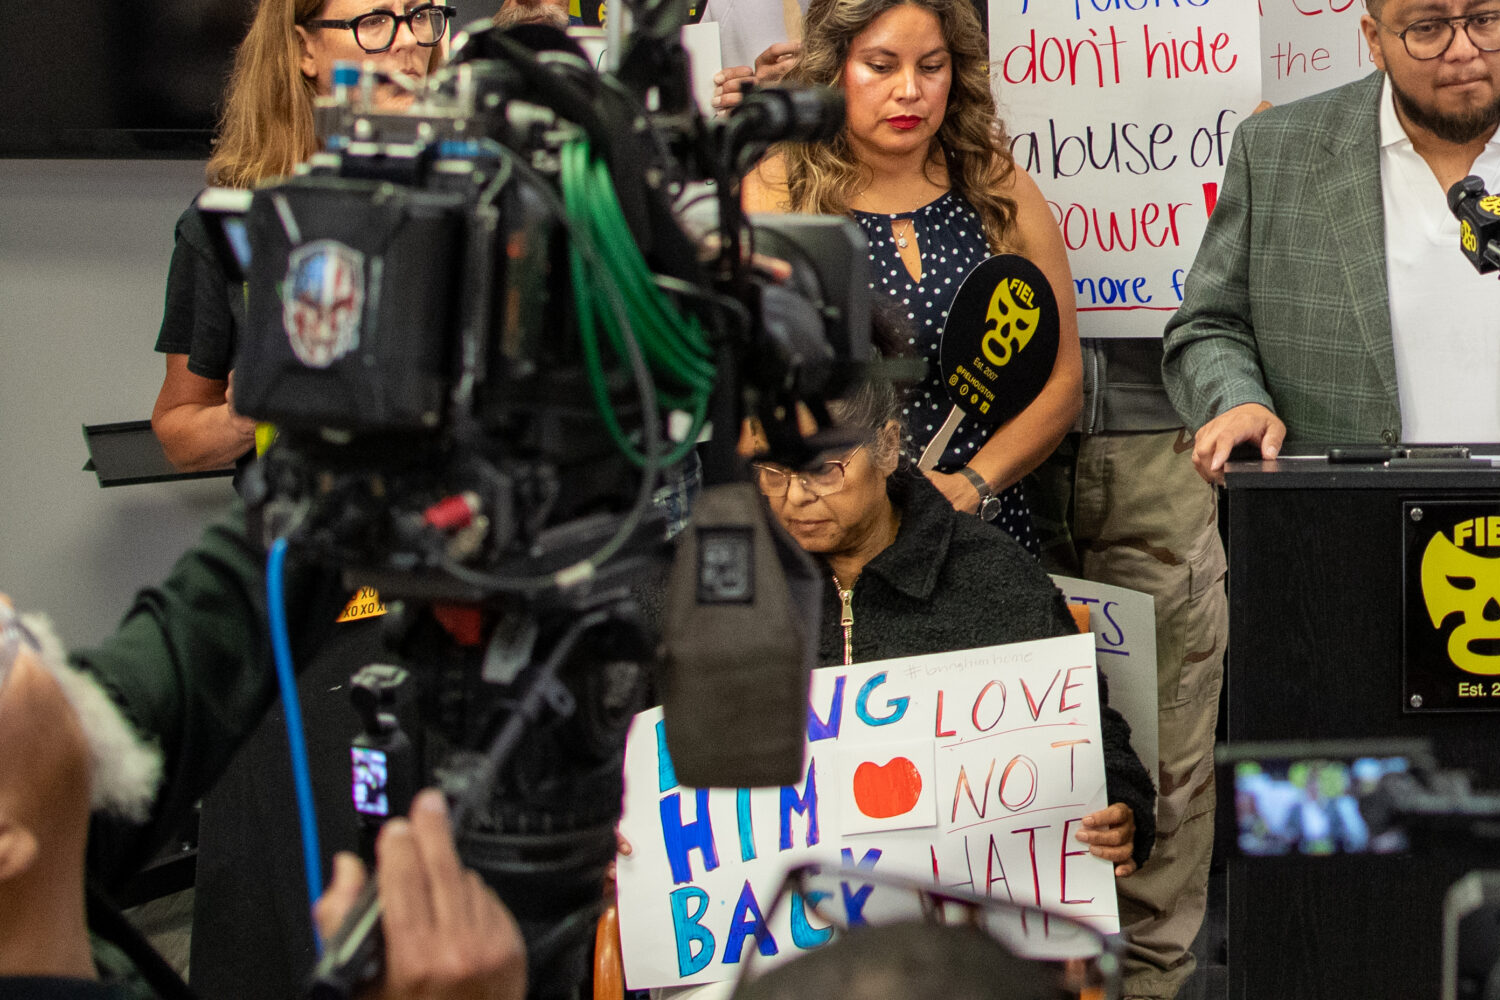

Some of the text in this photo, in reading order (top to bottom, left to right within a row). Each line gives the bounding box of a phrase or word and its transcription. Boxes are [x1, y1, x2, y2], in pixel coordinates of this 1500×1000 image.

[1002, 23, 1239, 88] don't hide
[1270, 41, 1332, 80] the
[1008, 110, 1237, 180] abuse of
[1008, 278, 1036, 310] FIEL
[1073, 276, 1152, 305] more
[955, 364, 996, 402] @FIELHOUSTON
[982, 365, 999, 382] 2007
[361, 602, 375, 616] XO
[935, 665, 1092, 738] LOVE
[1458, 682, 1487, 697] Est.
[951, 739, 1091, 823] NOT
[659, 757, 820, 885] HIM
[930, 818, 1095, 925] HATE
